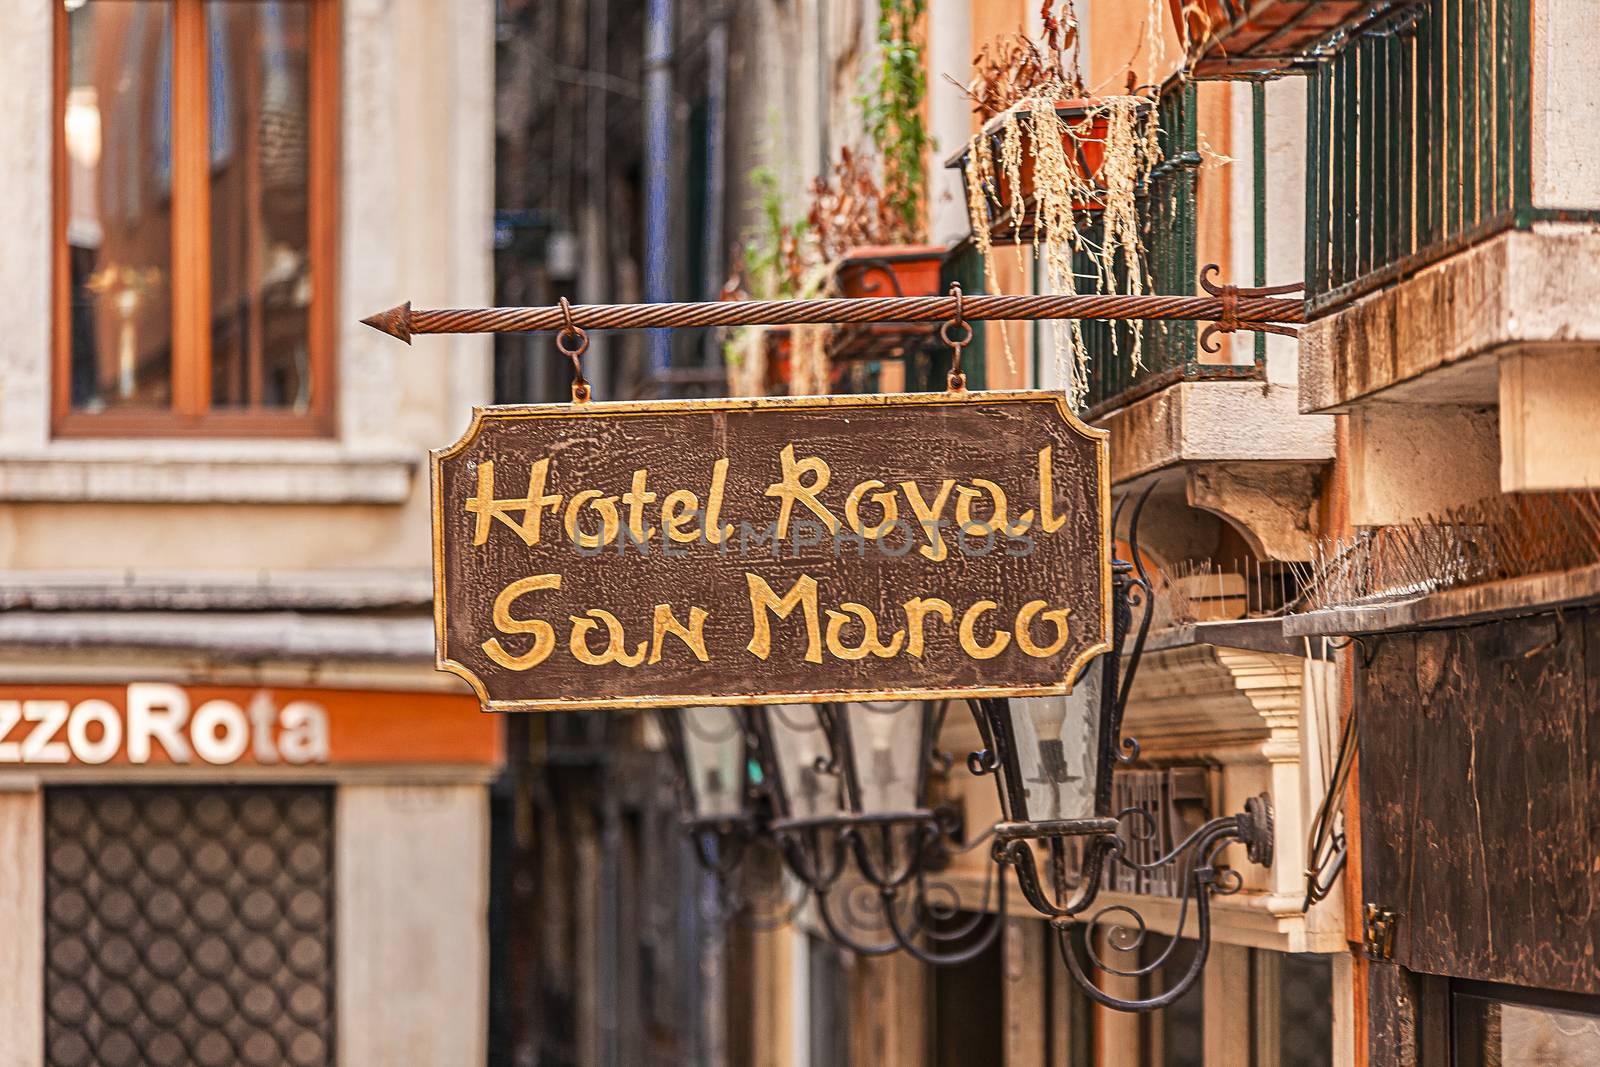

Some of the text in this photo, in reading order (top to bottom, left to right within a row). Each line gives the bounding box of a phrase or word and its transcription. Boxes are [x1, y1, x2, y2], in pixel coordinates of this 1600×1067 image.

[464, 443, 1067, 562] Hotel Royal
[745, 572, 1071, 664] Marco
